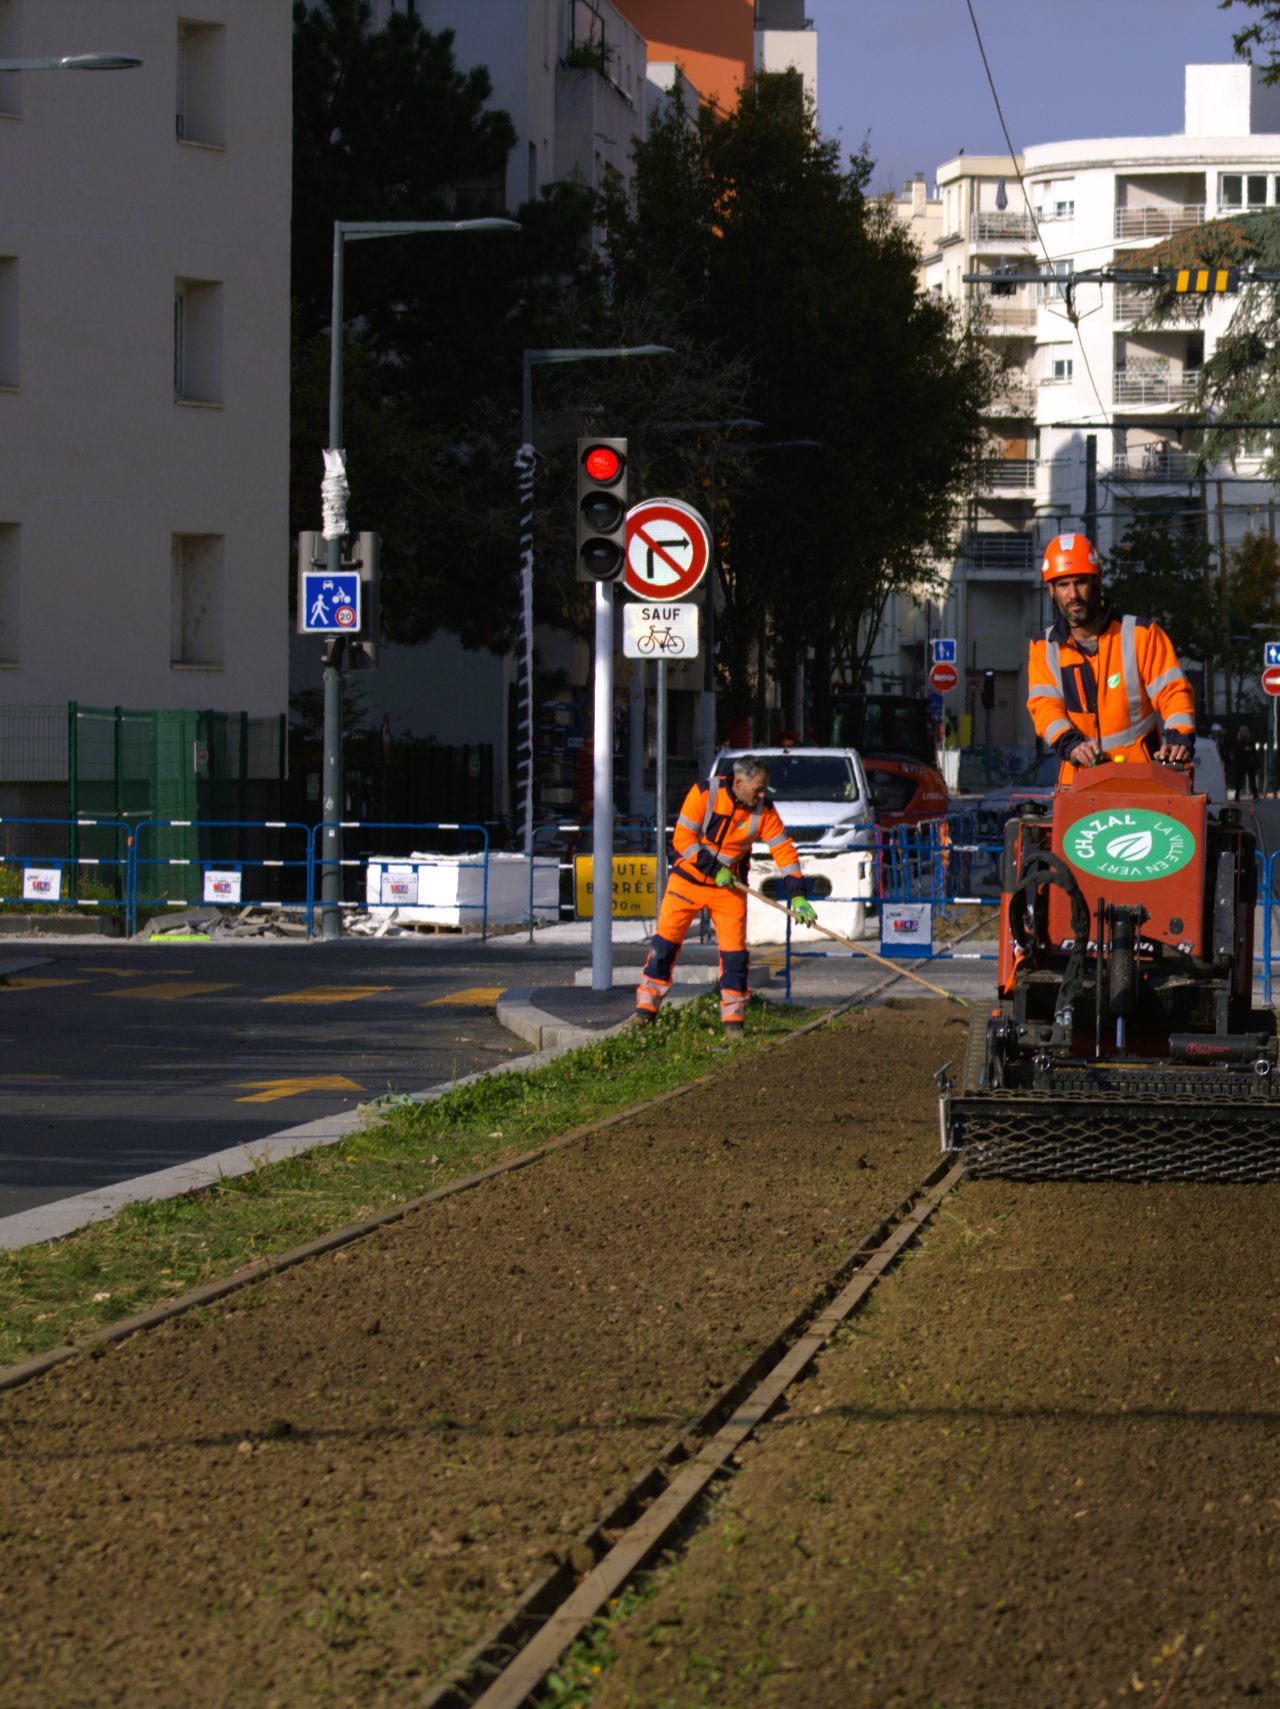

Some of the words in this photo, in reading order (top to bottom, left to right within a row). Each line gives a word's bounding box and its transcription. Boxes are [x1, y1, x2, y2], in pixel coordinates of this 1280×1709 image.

[340, 612, 352, 621] 20
[642, 608, 681, 620] SAUF
[1153, 821, 1173, 836] LA
[1075, 814, 1136, 859] CHAZAL
[1164, 834, 1185, 863] VILLE
[1097, 862, 1143, 876] VERT
[1145, 859, 1169, 874] EN
[586, 880, 655, 894] BRRÉE
